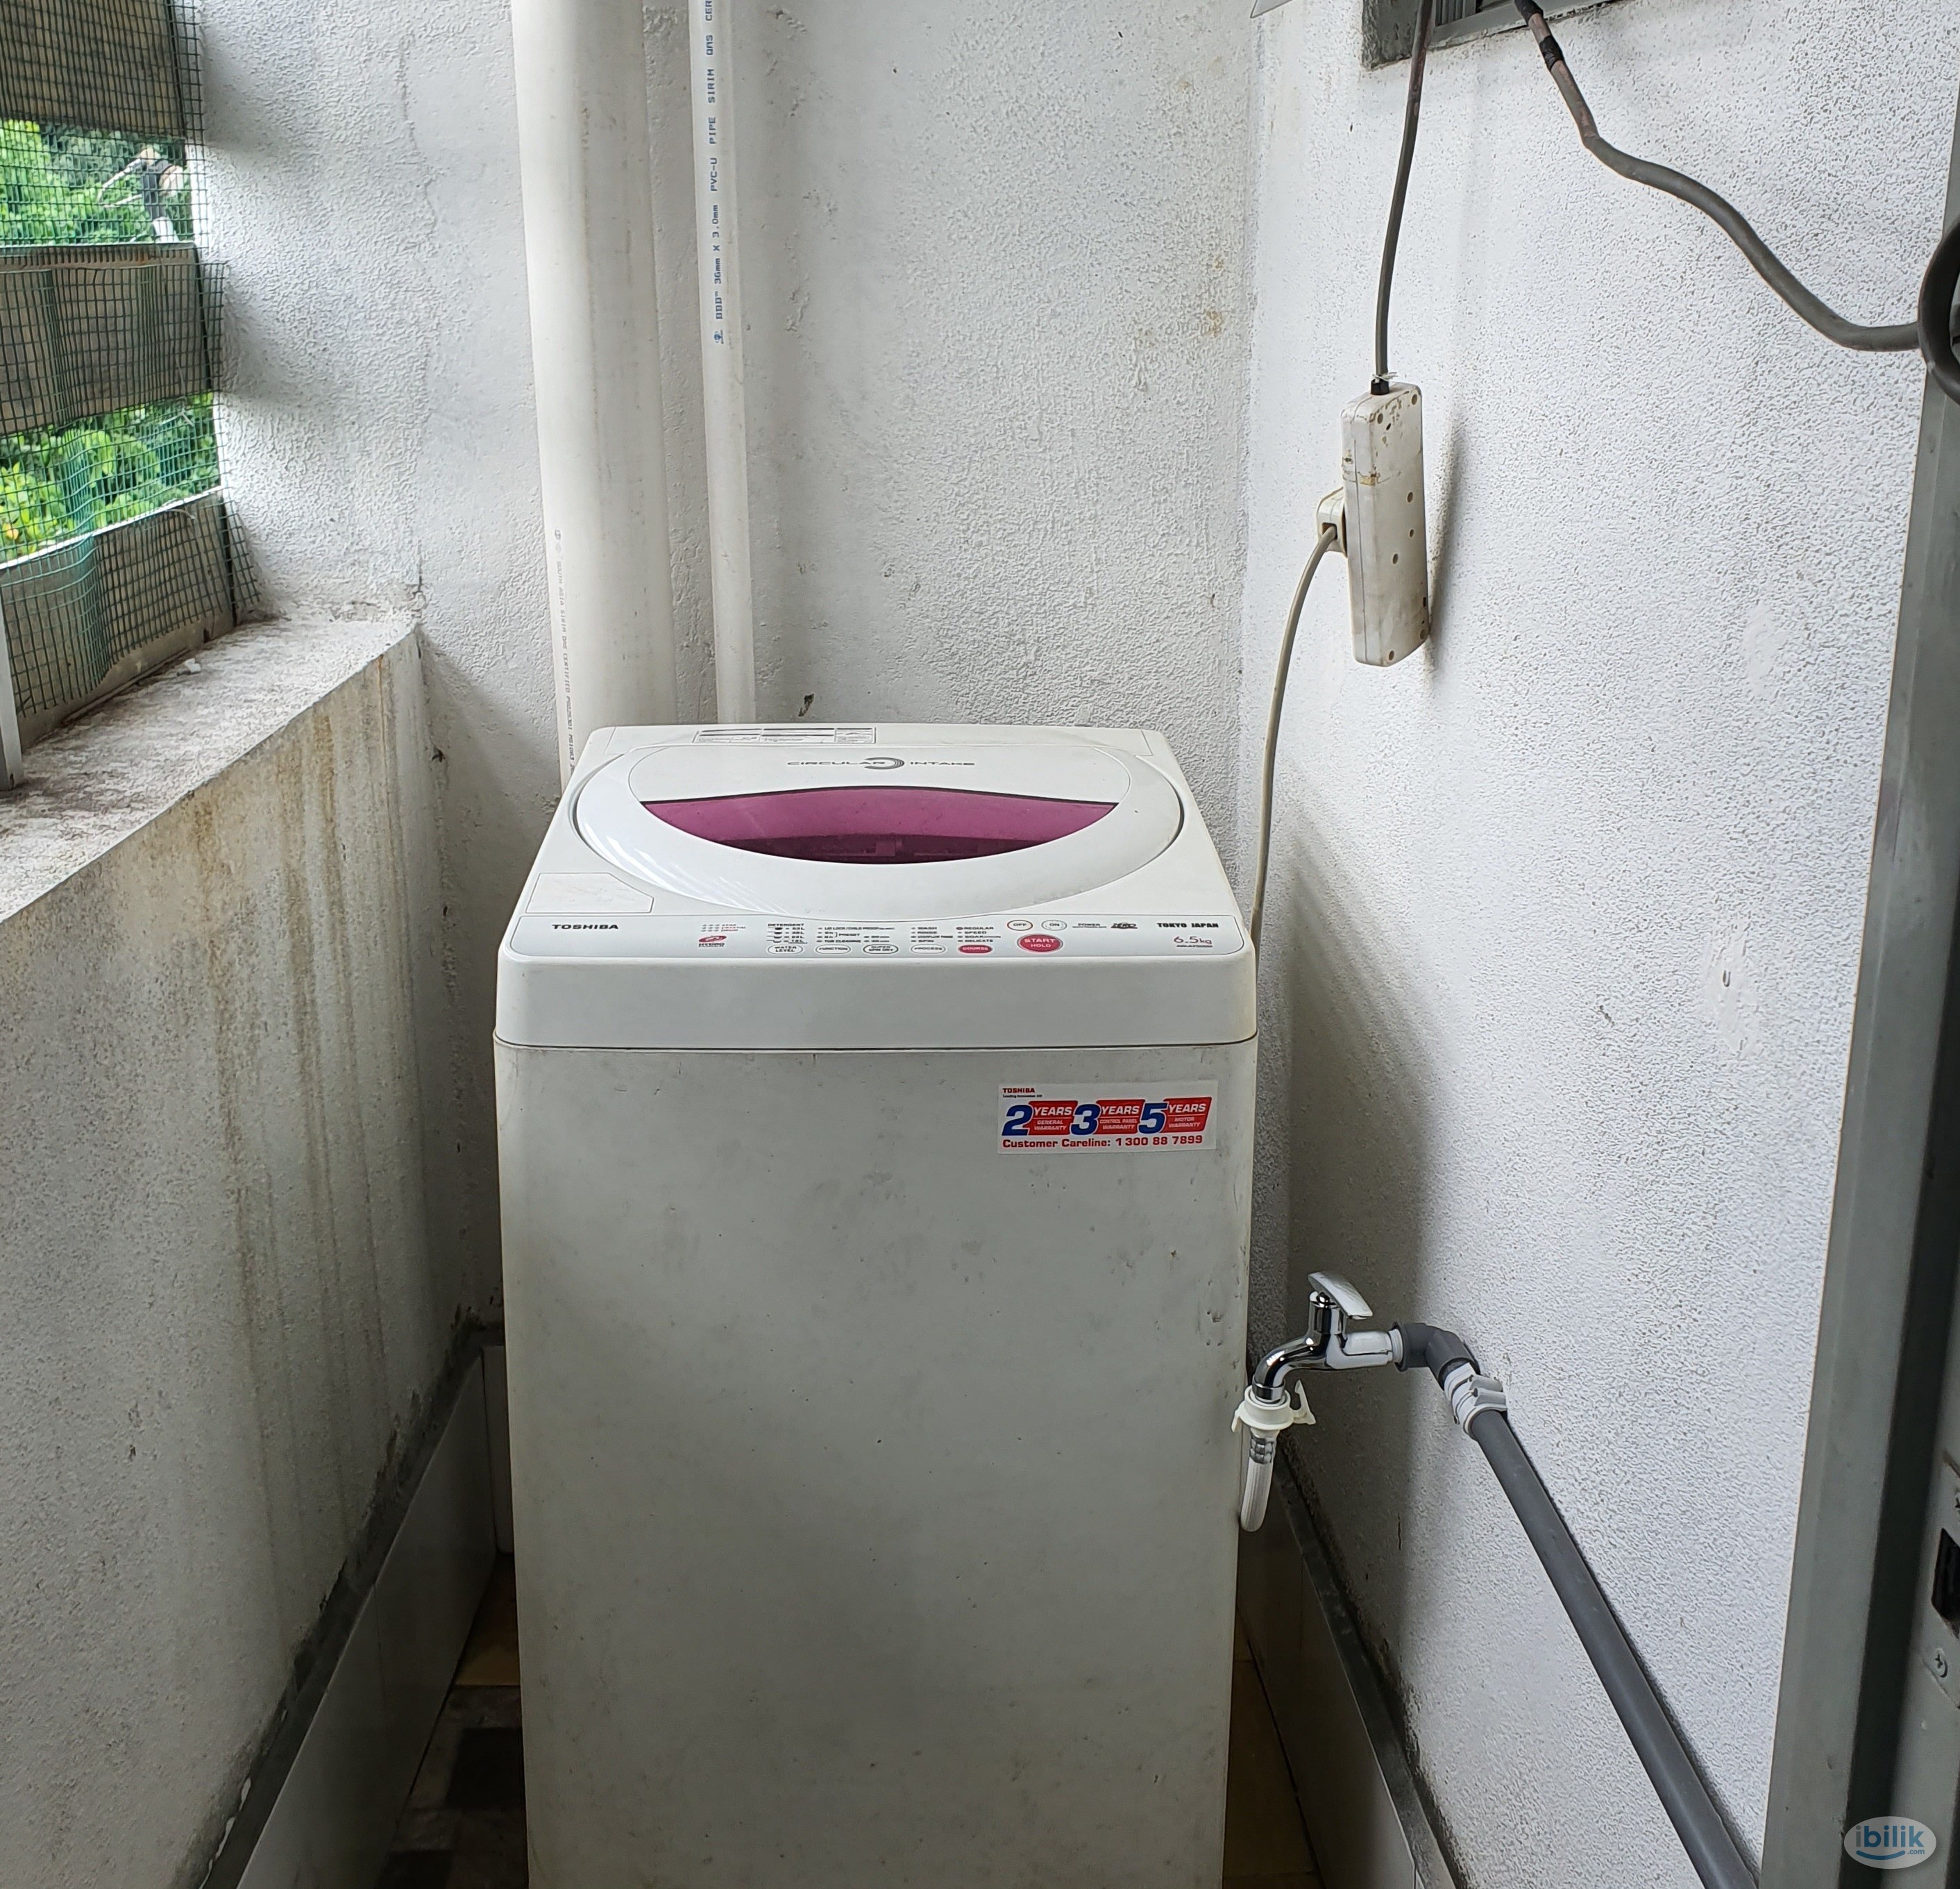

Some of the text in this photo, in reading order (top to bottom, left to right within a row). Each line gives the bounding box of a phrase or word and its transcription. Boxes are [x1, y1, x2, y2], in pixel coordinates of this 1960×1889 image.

[707, 69, 716, 103] SIRIM
[1174, 936, 1213, 945] 6.5kg
[1002, 1104, 1073, 1136] 2 YEARS
[1070, 1103, 1140, 1135] 3 YEARS
[1138, 1102, 1206, 1134] 5 YEARS
[1002, 1139, 1058, 1148] Customer
[1061, 1138, 1111, 1147] Careline:
[1152, 1136, 1168, 1145] 88
[1172, 1135, 1203, 1145] 7899
